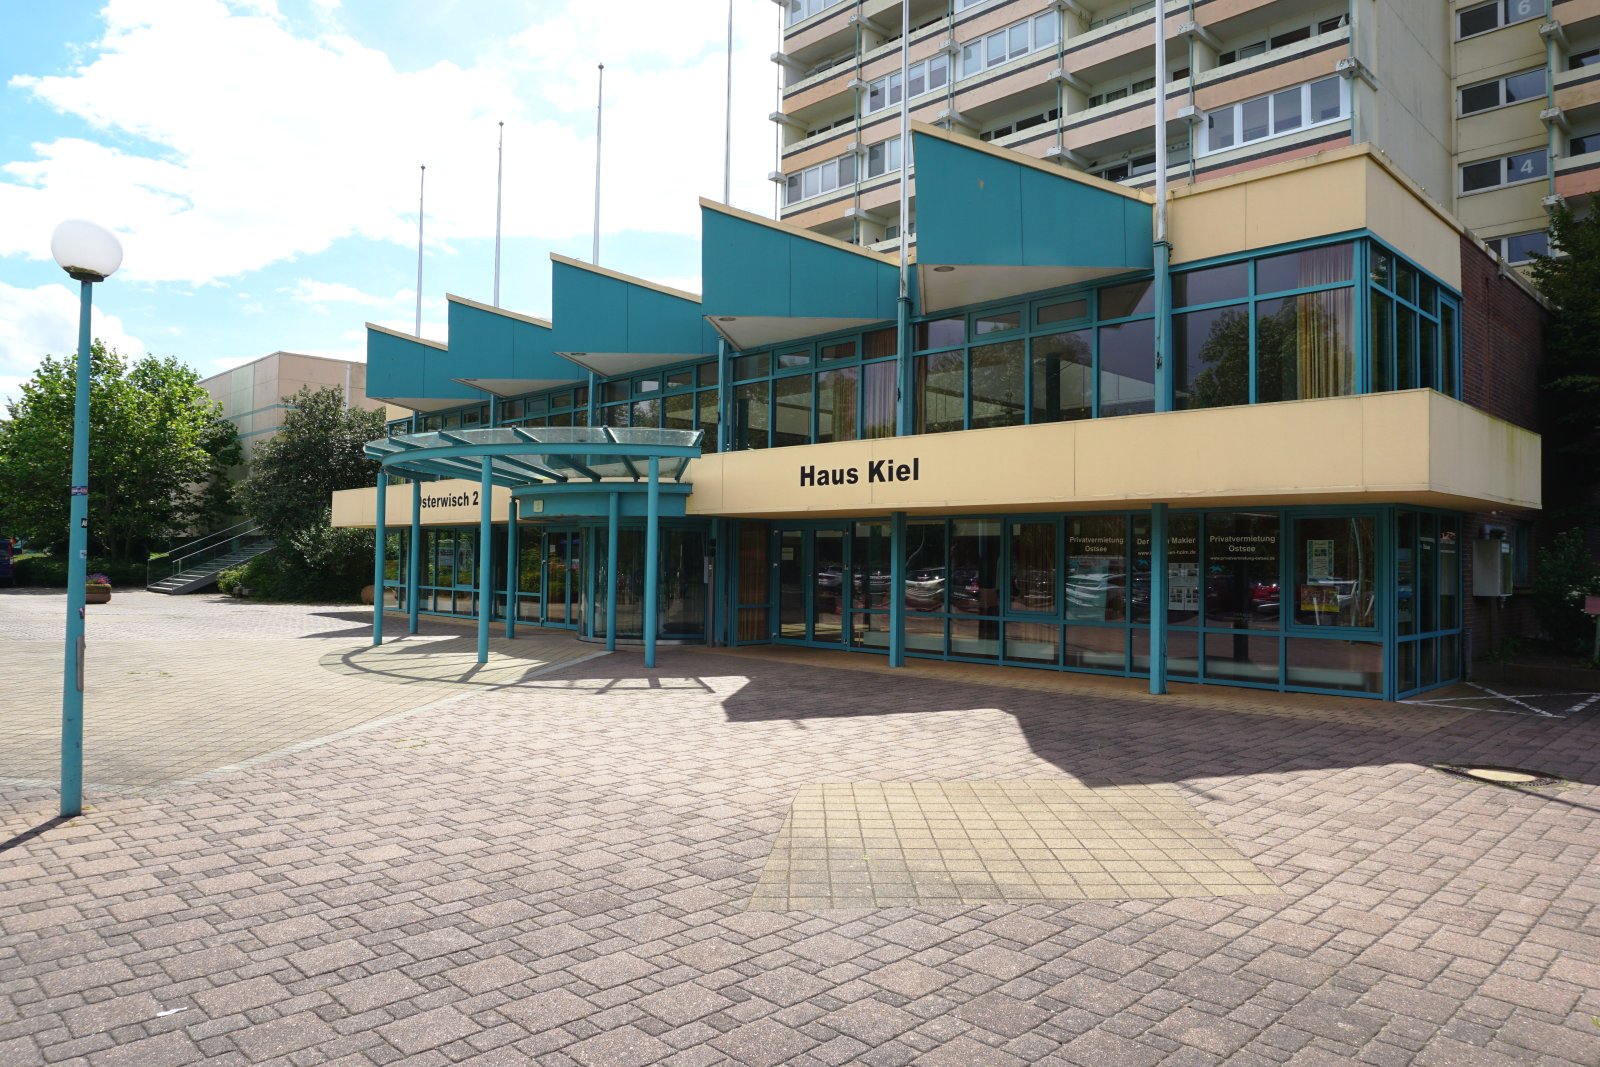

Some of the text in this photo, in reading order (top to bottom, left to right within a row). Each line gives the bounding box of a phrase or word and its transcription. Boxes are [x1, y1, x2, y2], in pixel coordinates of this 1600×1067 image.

[1518, 0, 1531, 15] 6
[1520, 159, 1534, 174] 4
[800, 457, 919, 487] Haus Kiel
[420, 490, 479, 508] sterwisch 2
[1069, 536, 1124, 545] Privatvermietung
[1208, 535, 1276, 544] Privatvermietung
